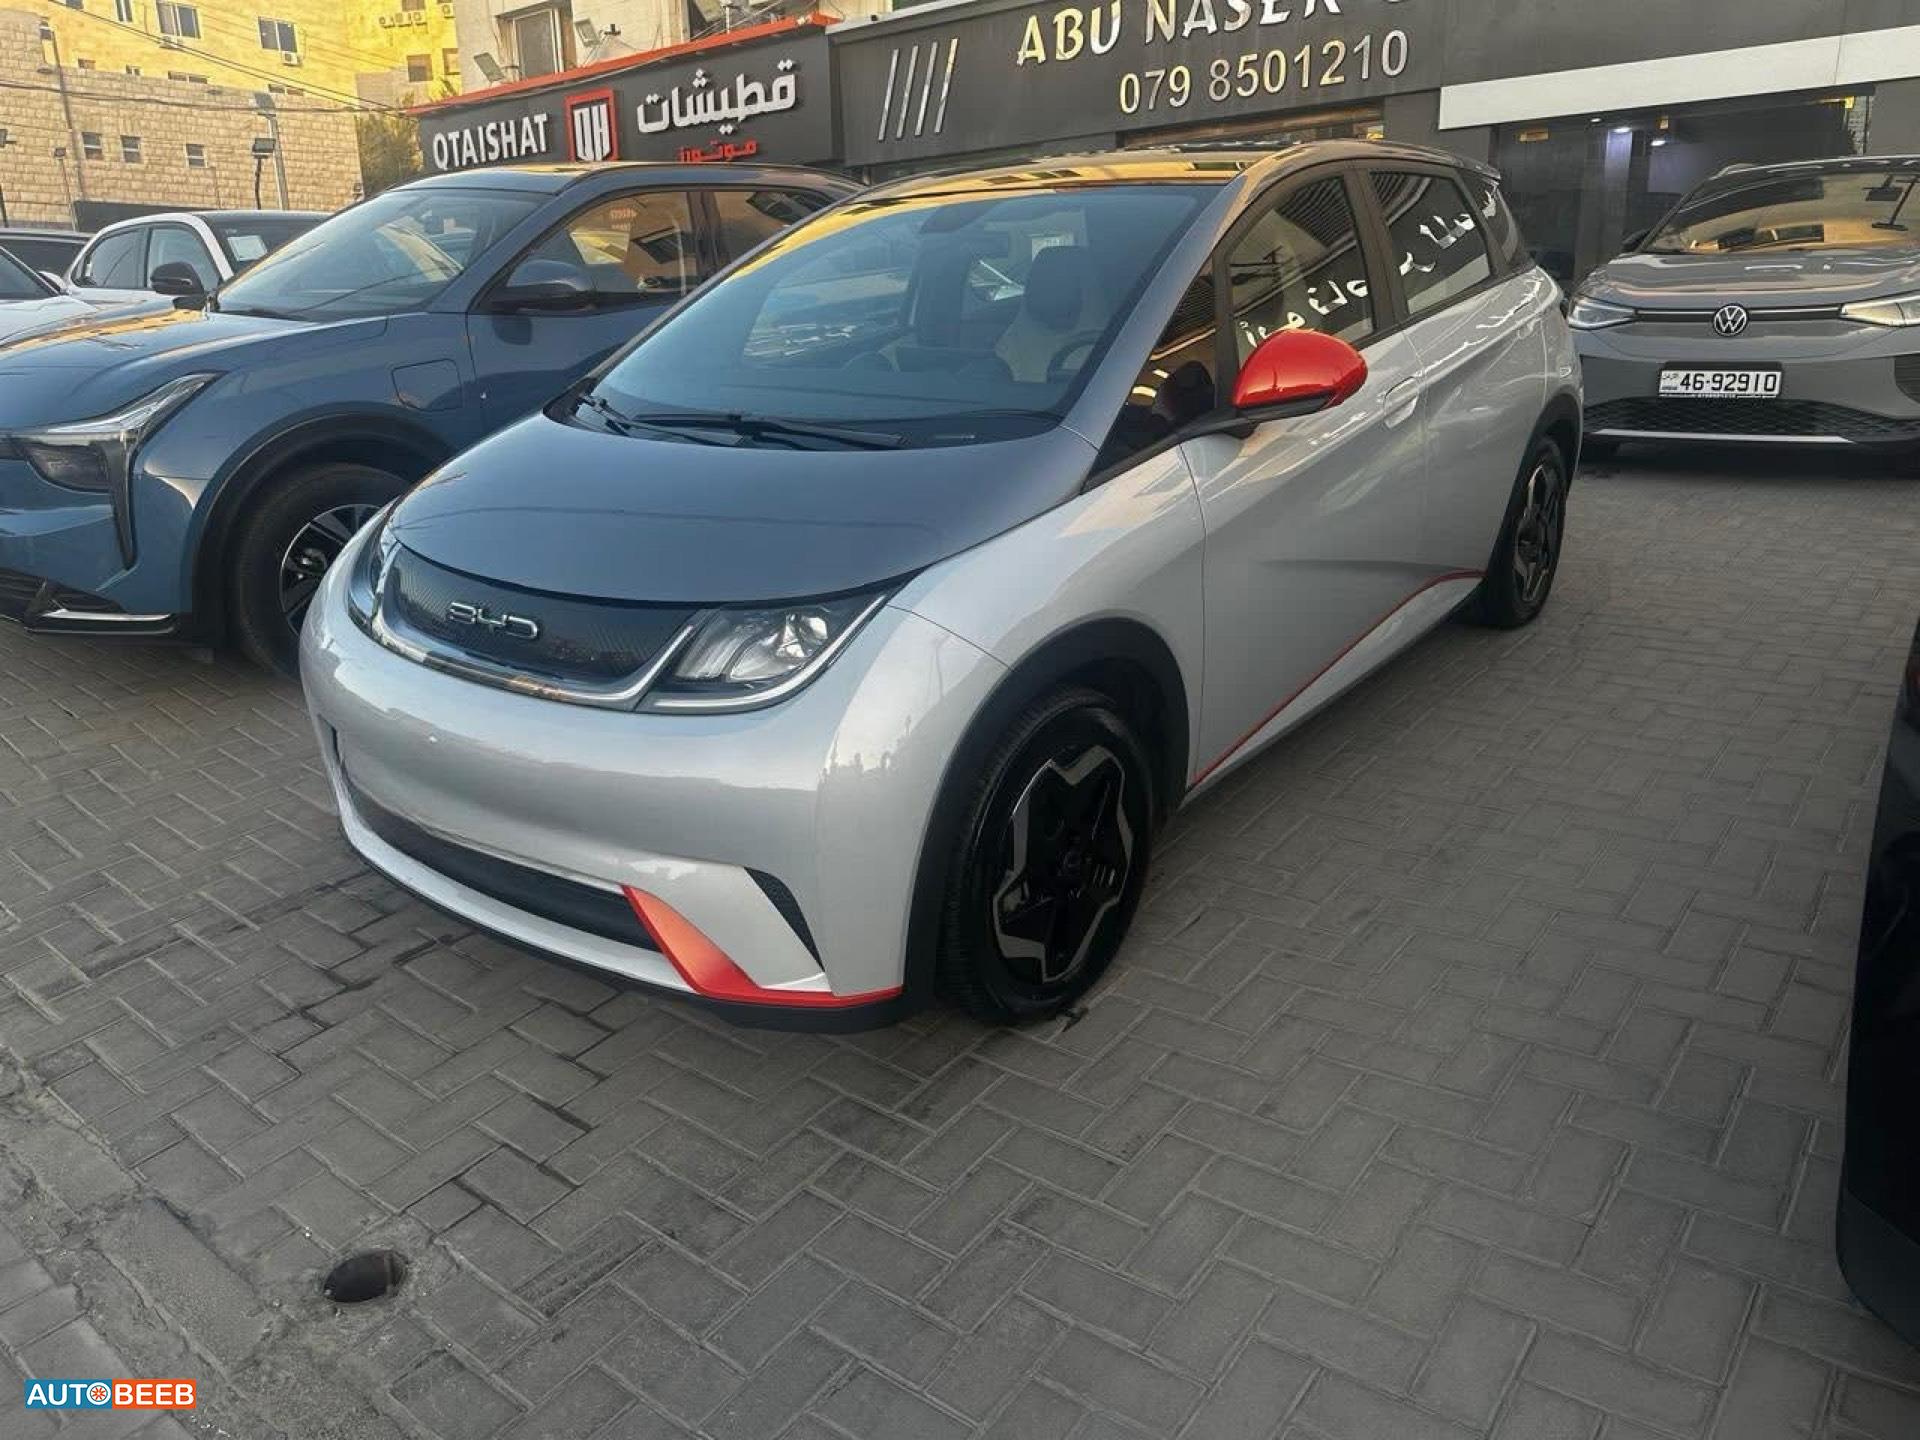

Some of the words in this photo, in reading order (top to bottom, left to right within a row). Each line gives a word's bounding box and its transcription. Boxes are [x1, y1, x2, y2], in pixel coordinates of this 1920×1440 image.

[1016, 0, 1122, 66] ABU
[636, 58, 797, 135] قطيشات
[1119, 65, 1191, 114] 079
[1208, 29, 1408, 102] 8501210
[432, 113, 548, 171] QTAISHAT
[446, 601, 538, 638] BYD
